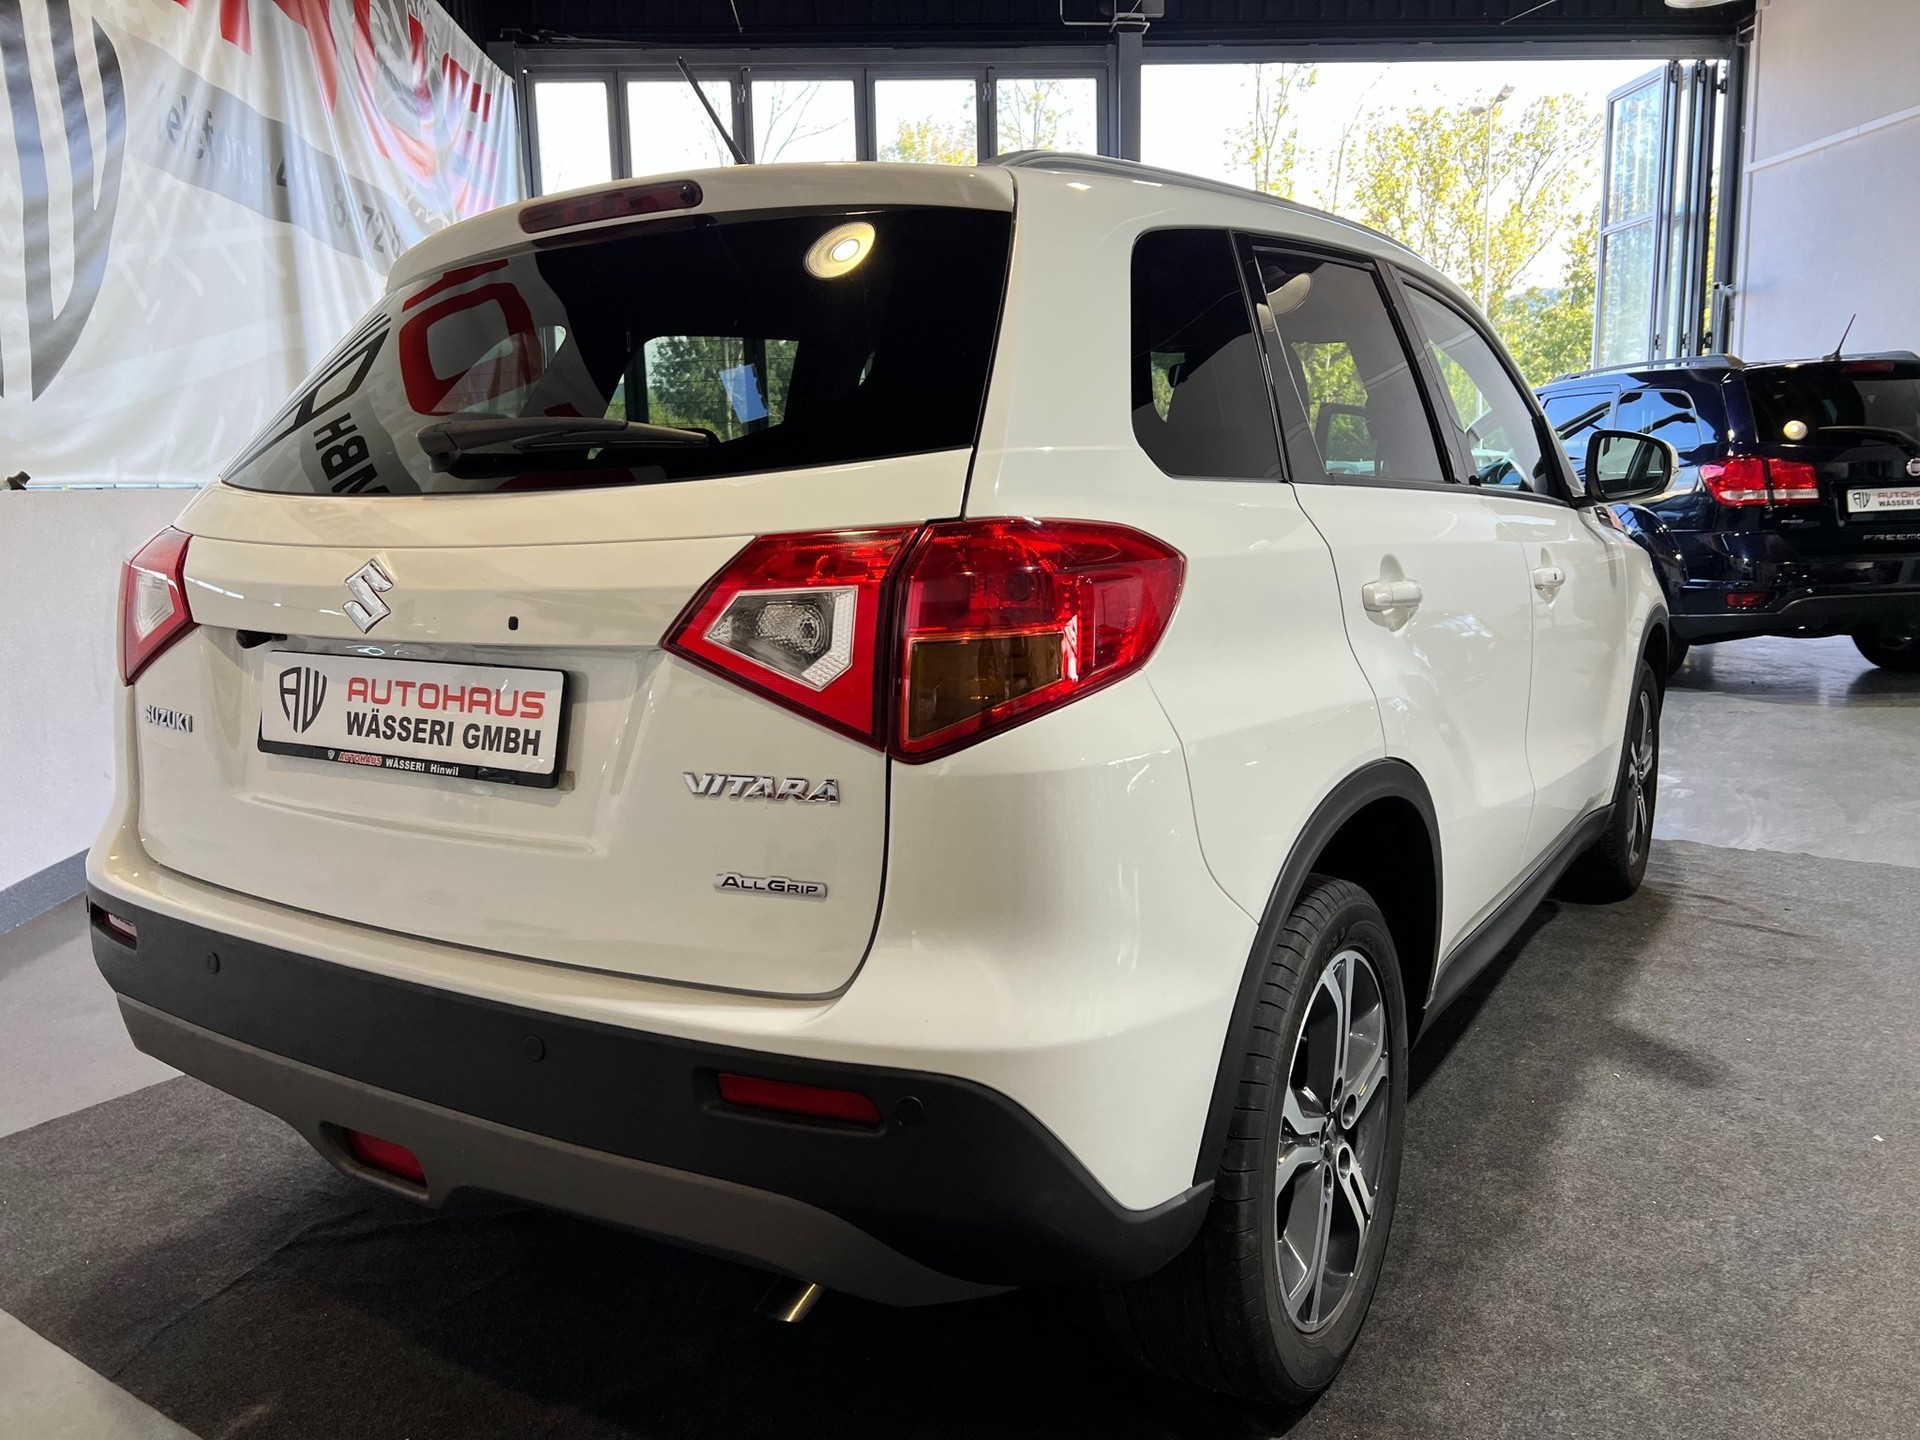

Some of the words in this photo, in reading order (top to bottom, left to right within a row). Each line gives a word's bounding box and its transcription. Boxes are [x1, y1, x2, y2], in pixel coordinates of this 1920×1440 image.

[347, 677, 546, 720] AUTOHAUS
[145, 705, 193, 733] SUZUKI
[346, 708, 455, 747] WÄSSERI
[462, 723, 542, 757] GMBH
[338, 751, 383, 767] AUTOHAUS
[385, 757, 425, 772] WÄSSERI
[430, 763, 459, 776] Hinwil
[682, 772, 840, 804] VITARA
